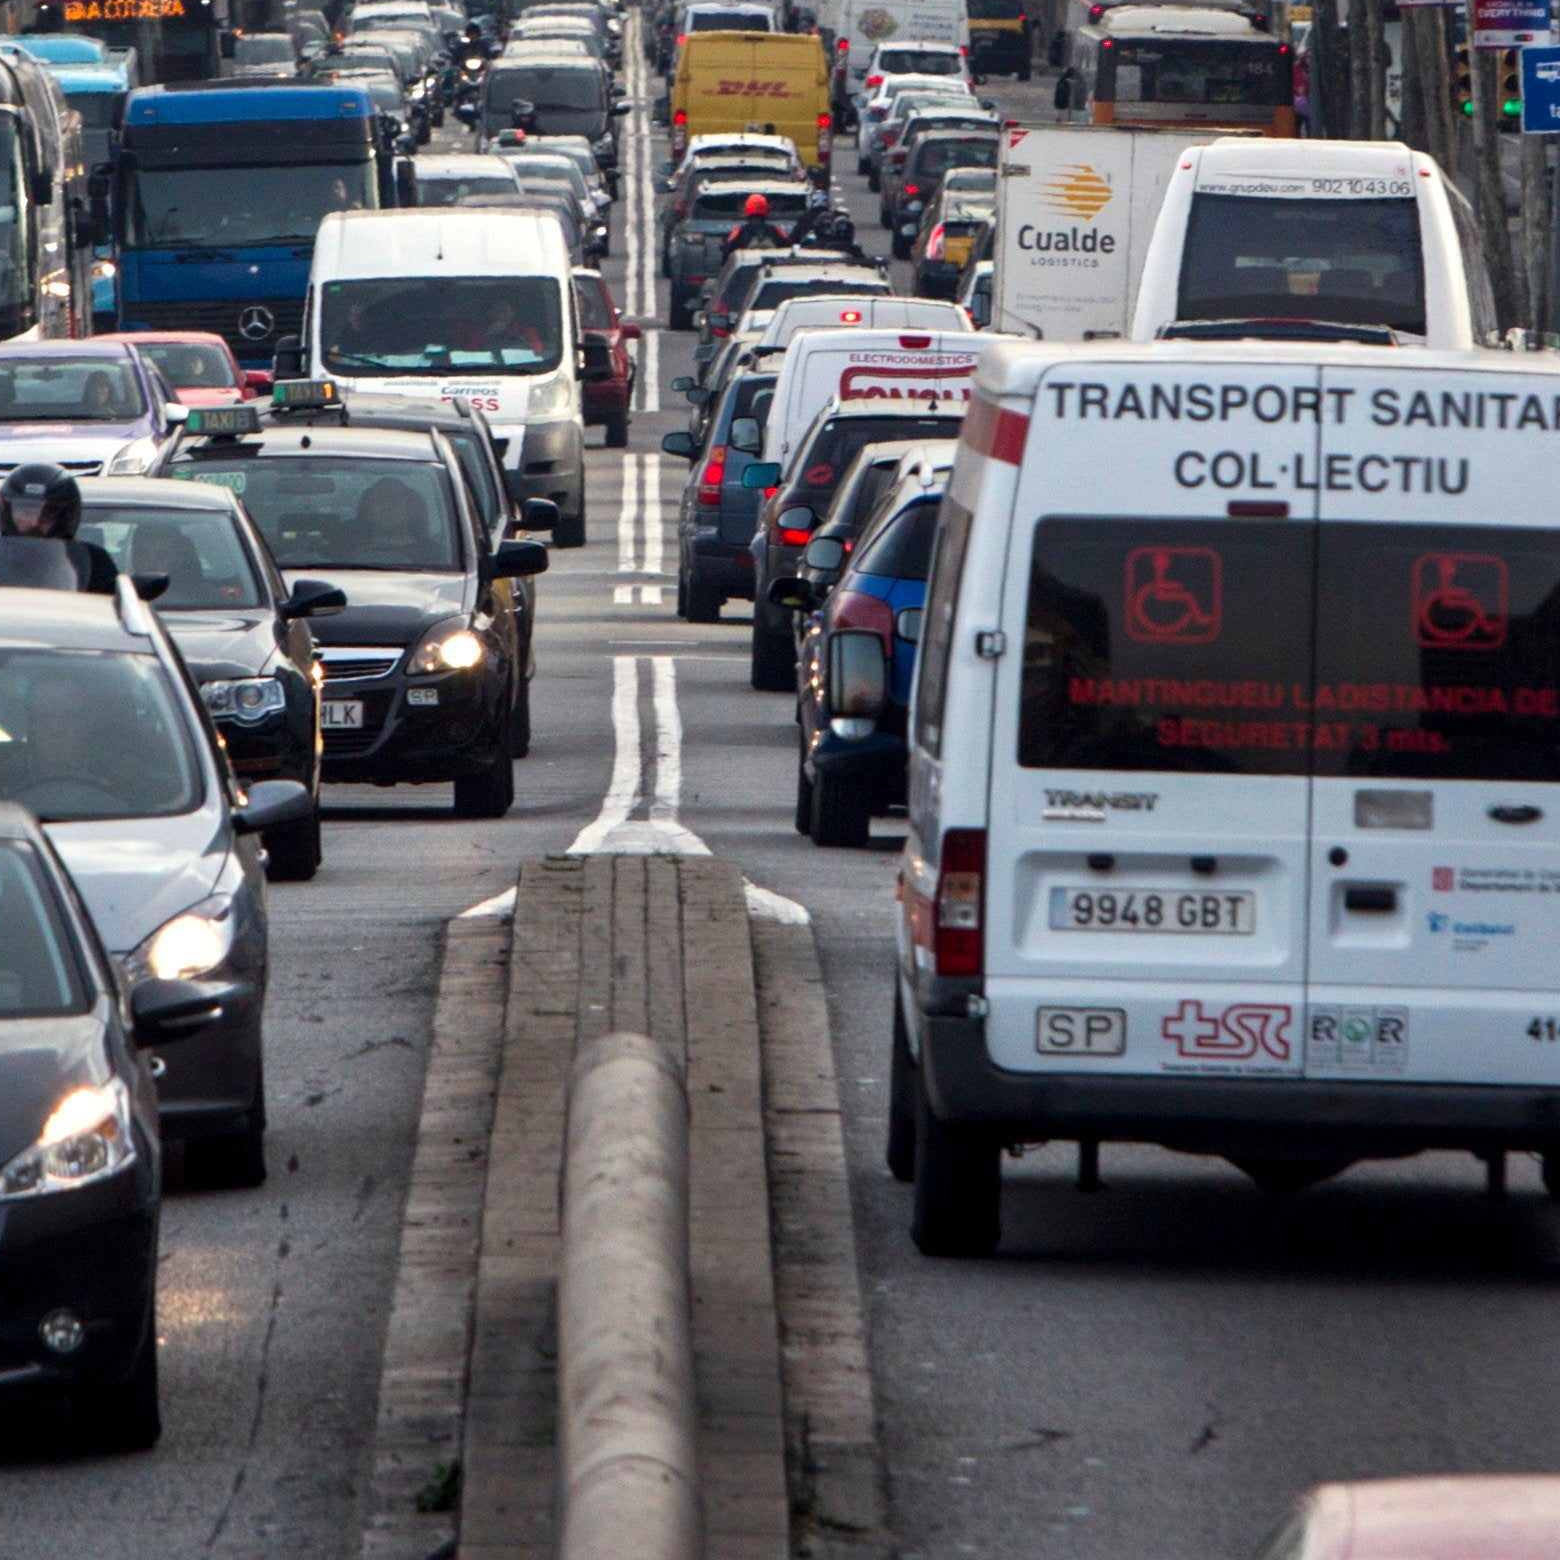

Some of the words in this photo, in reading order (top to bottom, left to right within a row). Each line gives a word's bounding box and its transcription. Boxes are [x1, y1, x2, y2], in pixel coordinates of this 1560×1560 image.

[1478, 7, 1546, 19] EVERYTHING
[716, 80, 792, 99] DHL
[1312, 178, 1344, 194] 902
[1018, 224, 1117, 255] Cualde
[1030, 256, 1100, 269] LOGISTICS
[440, 385, 499, 396] Correos
[1047, 380, 1356, 425] TRANSPORT
[1174, 449, 1469, 496] COL·LECTIU
[1067, 677, 1283, 709] MANTINGUEU
[1514, 688, 1560, 717] DE
[1156, 717, 1354, 753] SEGURETAT
[1042, 788, 1160, 813] TRANSIT
[1072, 893, 1165, 927] 9948
[1176, 895, 1245, 929] GBT
[1048, 1012, 1114, 1048] SP
